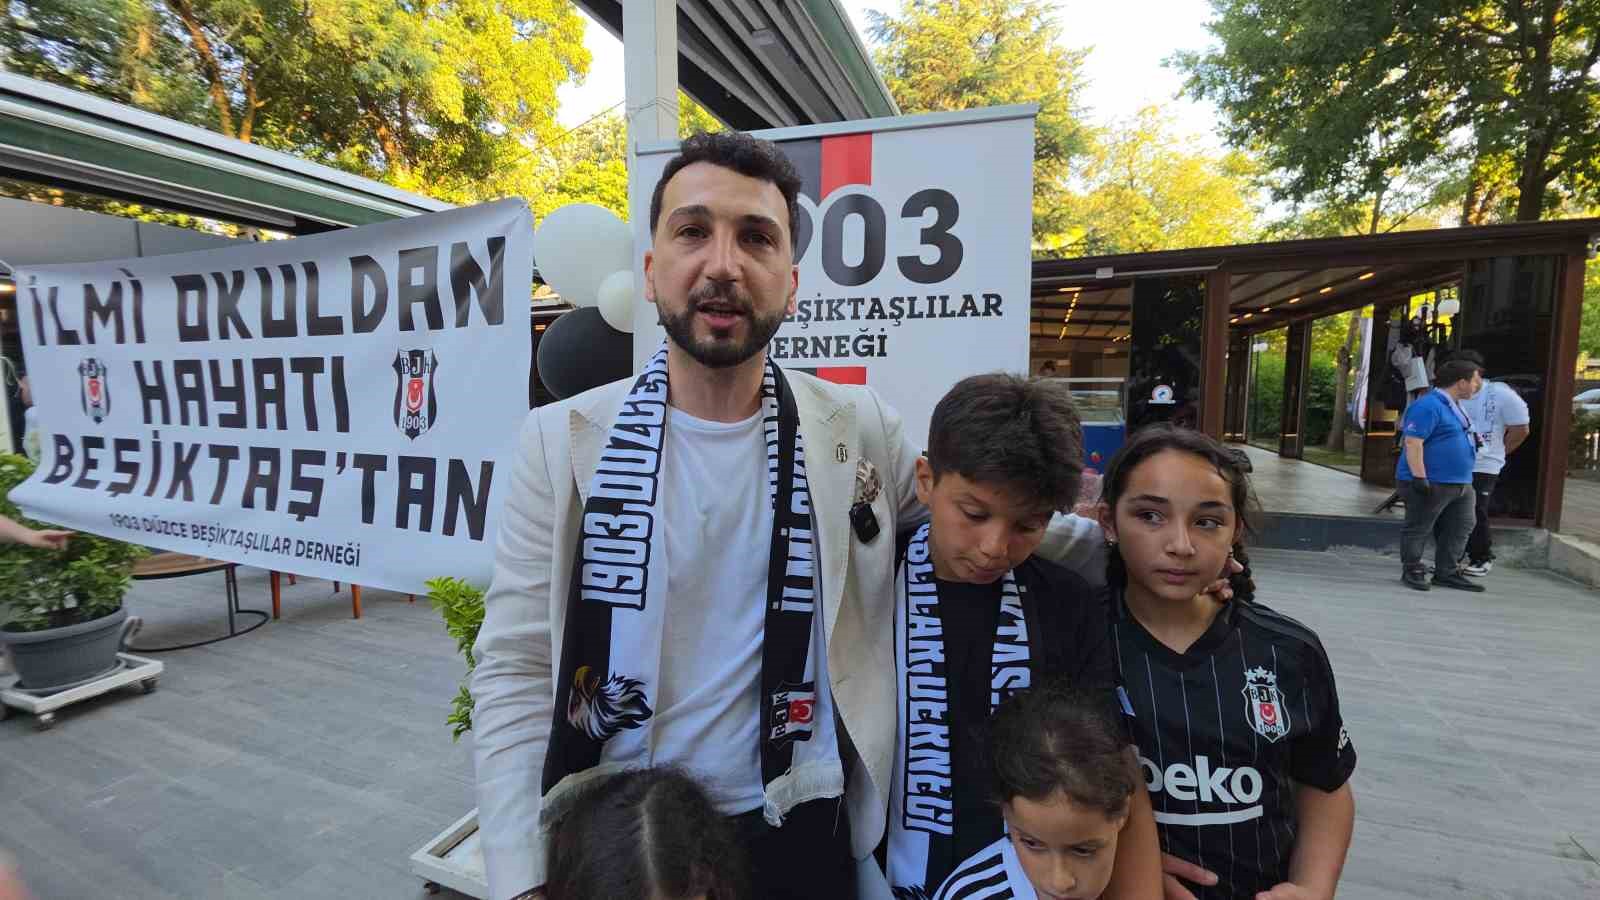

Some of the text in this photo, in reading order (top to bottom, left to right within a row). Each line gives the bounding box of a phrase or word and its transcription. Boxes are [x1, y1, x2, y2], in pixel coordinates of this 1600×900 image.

[27, 236, 506, 346] İLMİ OKULDAN
[768, 327, 888, 360] ERNEĞİ
[133, 356, 350, 433] HAYATI
[402, 415, 427, 430] 1903
[42, 430, 495, 541] BEŞİKTAŞ'TAN
[109, 512, 361, 568] 1903 DÜZCE BEŞİKTAŞLILAR DERNEĞİ
[581, 510, 653, 610] 1903
